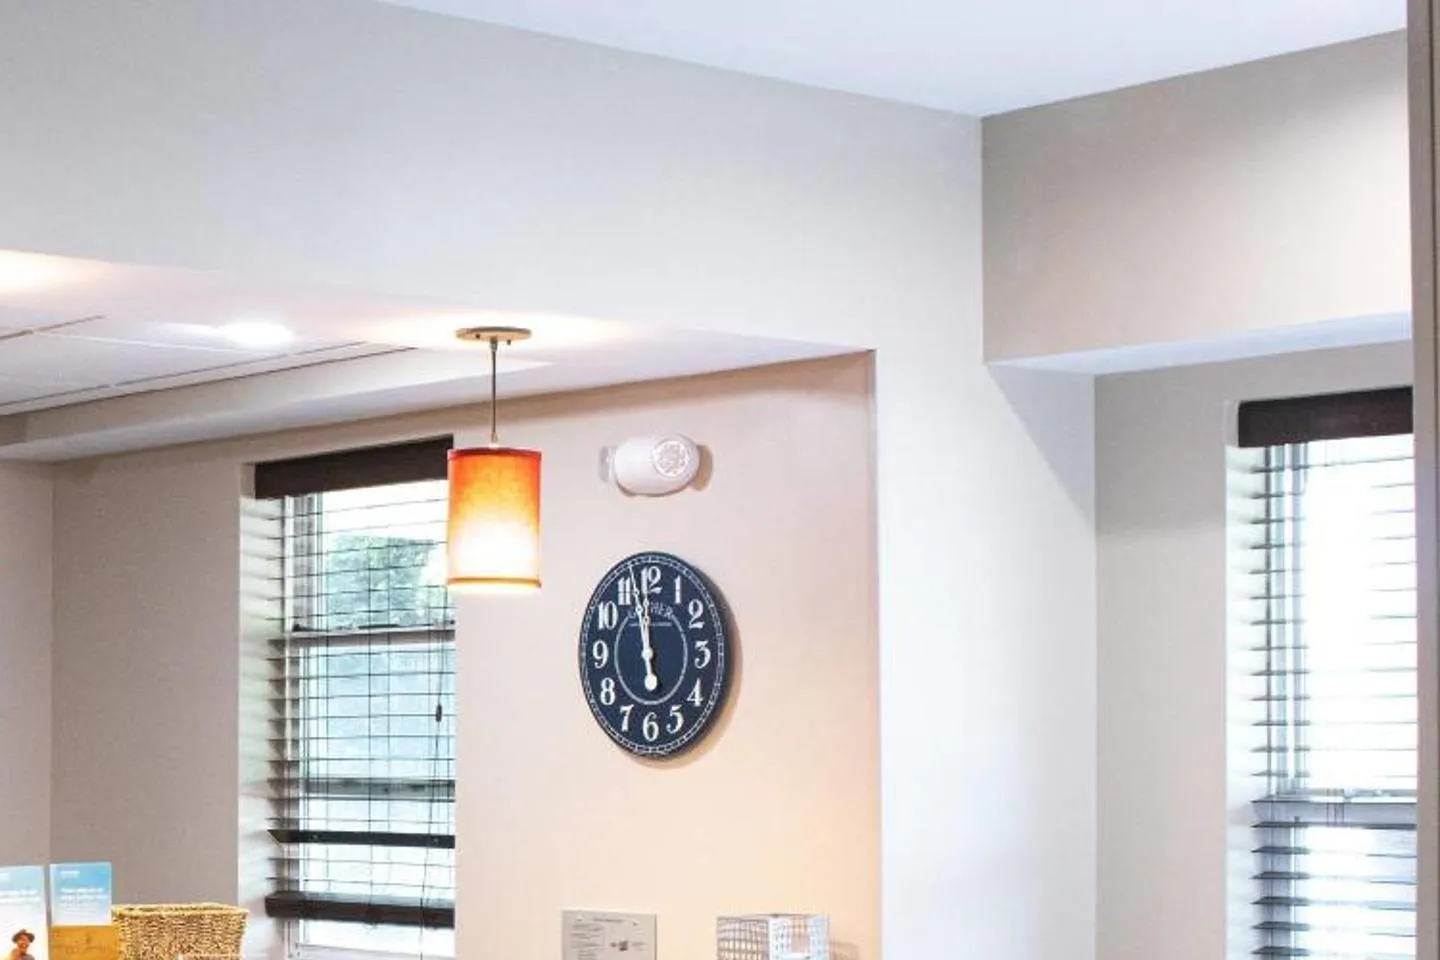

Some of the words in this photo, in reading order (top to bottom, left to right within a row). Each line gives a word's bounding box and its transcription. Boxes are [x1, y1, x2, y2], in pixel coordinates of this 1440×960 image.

[617, 577, 633, 606] 11
[641, 566, 663, 595] 12
[674, 575, 682, 604] 1
[597, 600, 619, 630] 10
[688, 600, 705, 629] 2
[592, 640, 609, 669] 9
[694, 640, 711, 669] 3
[600, 677, 616, 706] 8
[687, 678, 704, 707] 4
[619, 703, 635, 732] 7
[642, 712, 659, 742] 6
[666, 705, 684, 734] 5
